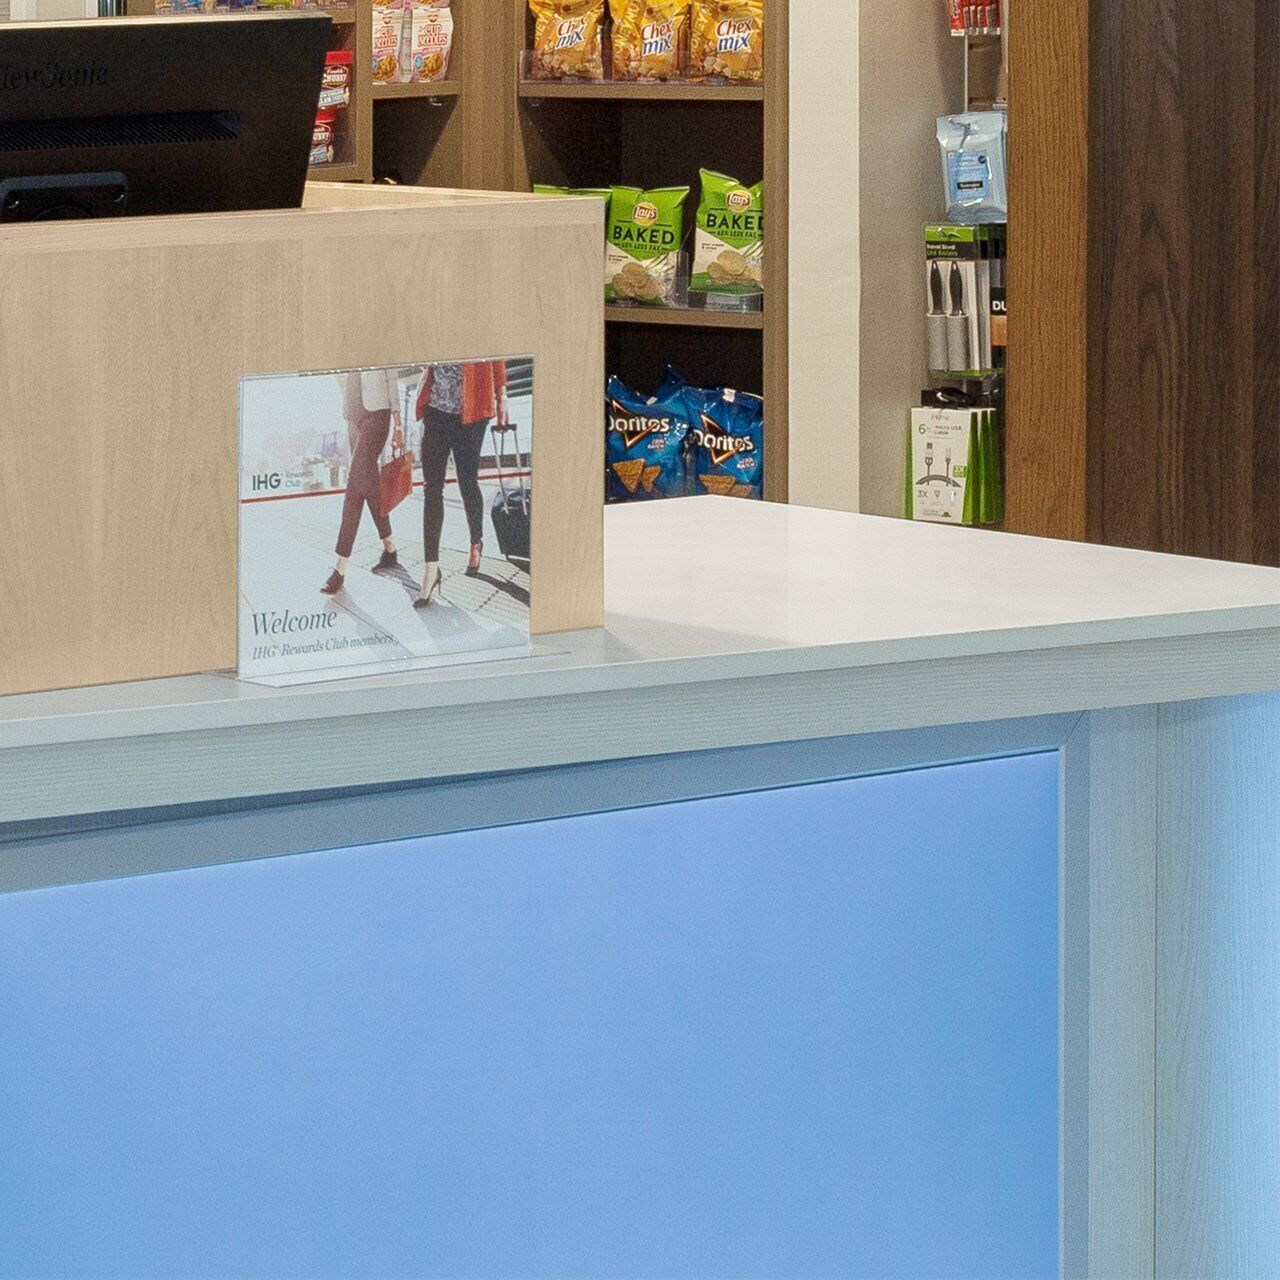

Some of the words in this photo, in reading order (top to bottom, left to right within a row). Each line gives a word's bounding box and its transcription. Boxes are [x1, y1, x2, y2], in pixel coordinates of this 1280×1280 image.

[554, 25, 587, 49] mix
[641, 18, 674, 41] Chex
[716, 16, 754, 37] Chex
[642, 32, 674, 57] mix
[717, 32, 752, 54] mix
[613, 225, 676, 245] BAKED
[918, 423, 926, 435] 6
[252, 472, 281, 491] IHG
[252, 609, 338, 636] Welcome
[281, 639, 324, 656] Rewards
[325, 636, 349, 651] Club
[350, 632, 396, 648] members
